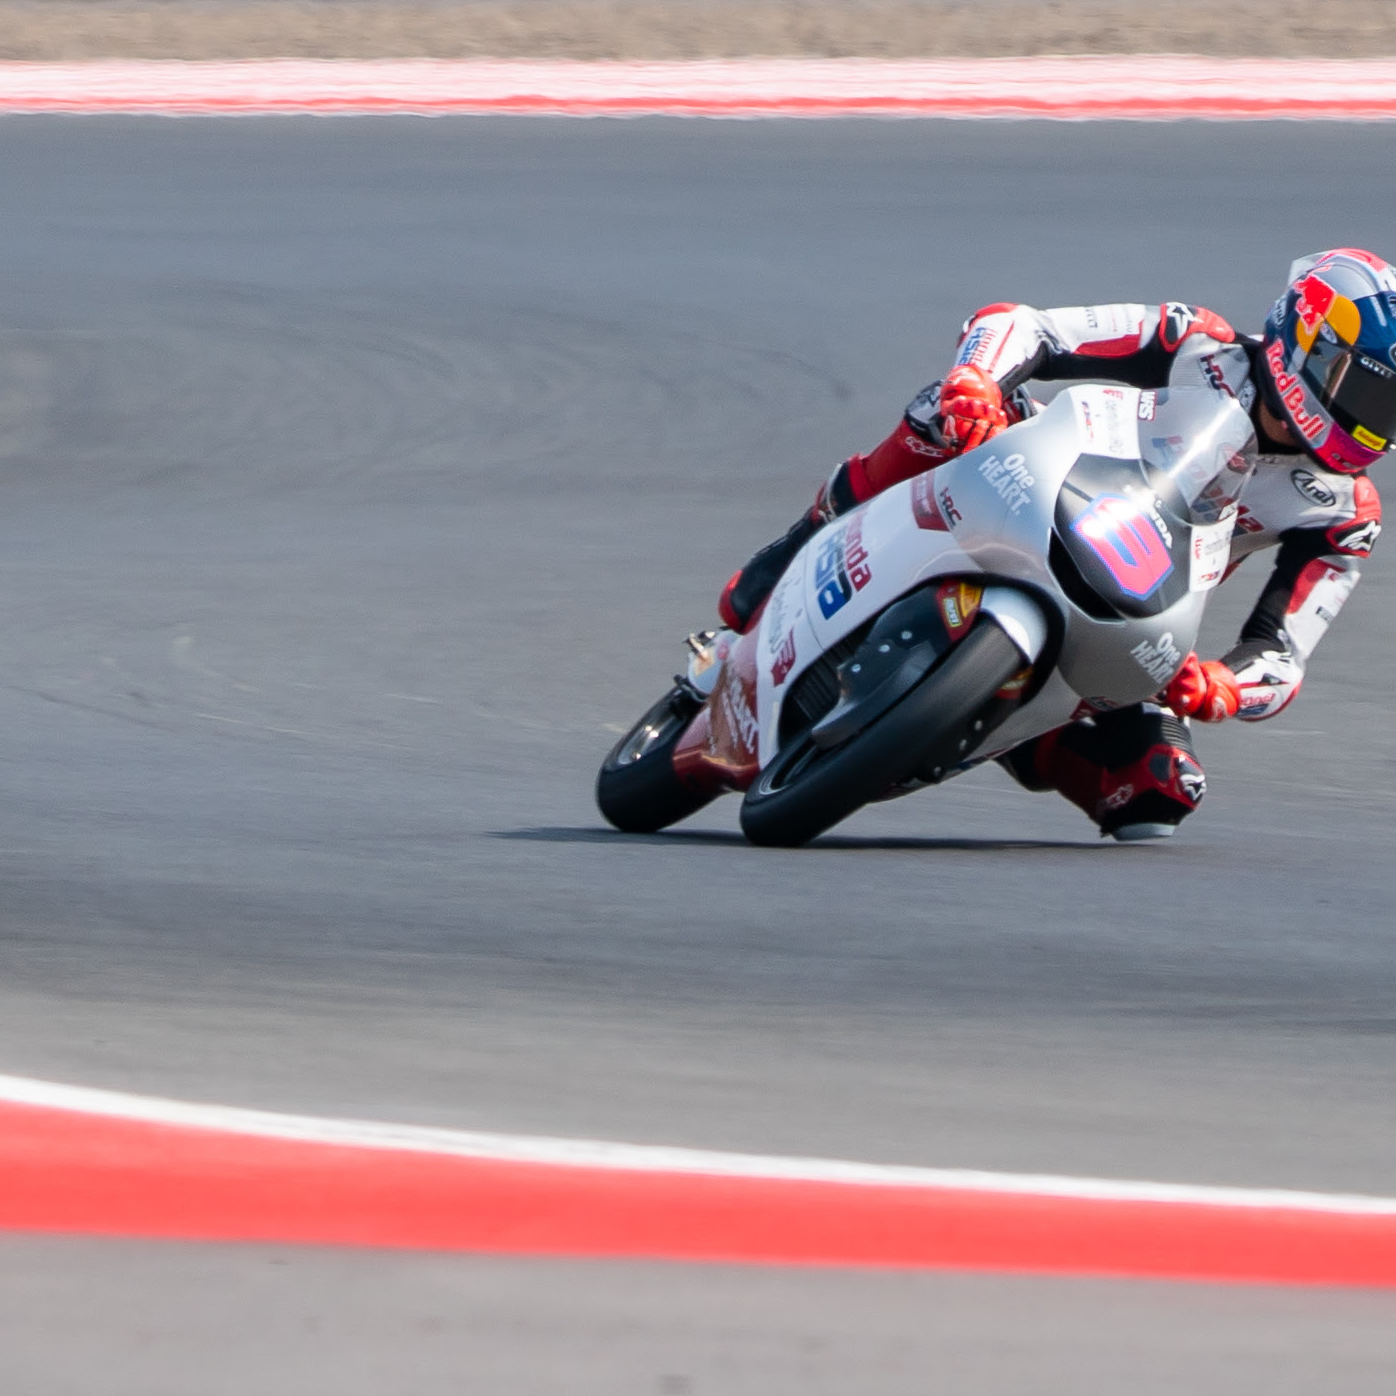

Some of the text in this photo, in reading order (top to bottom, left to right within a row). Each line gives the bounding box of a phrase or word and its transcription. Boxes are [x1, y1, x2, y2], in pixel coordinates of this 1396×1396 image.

[1266, 339, 1325, 440] Red Bull
[1004, 453, 1035, 489] One
[1298, 474, 1335, 504] Arai
[939, 486, 963, 526] HRC
[1156, 632, 1182, 666] One
